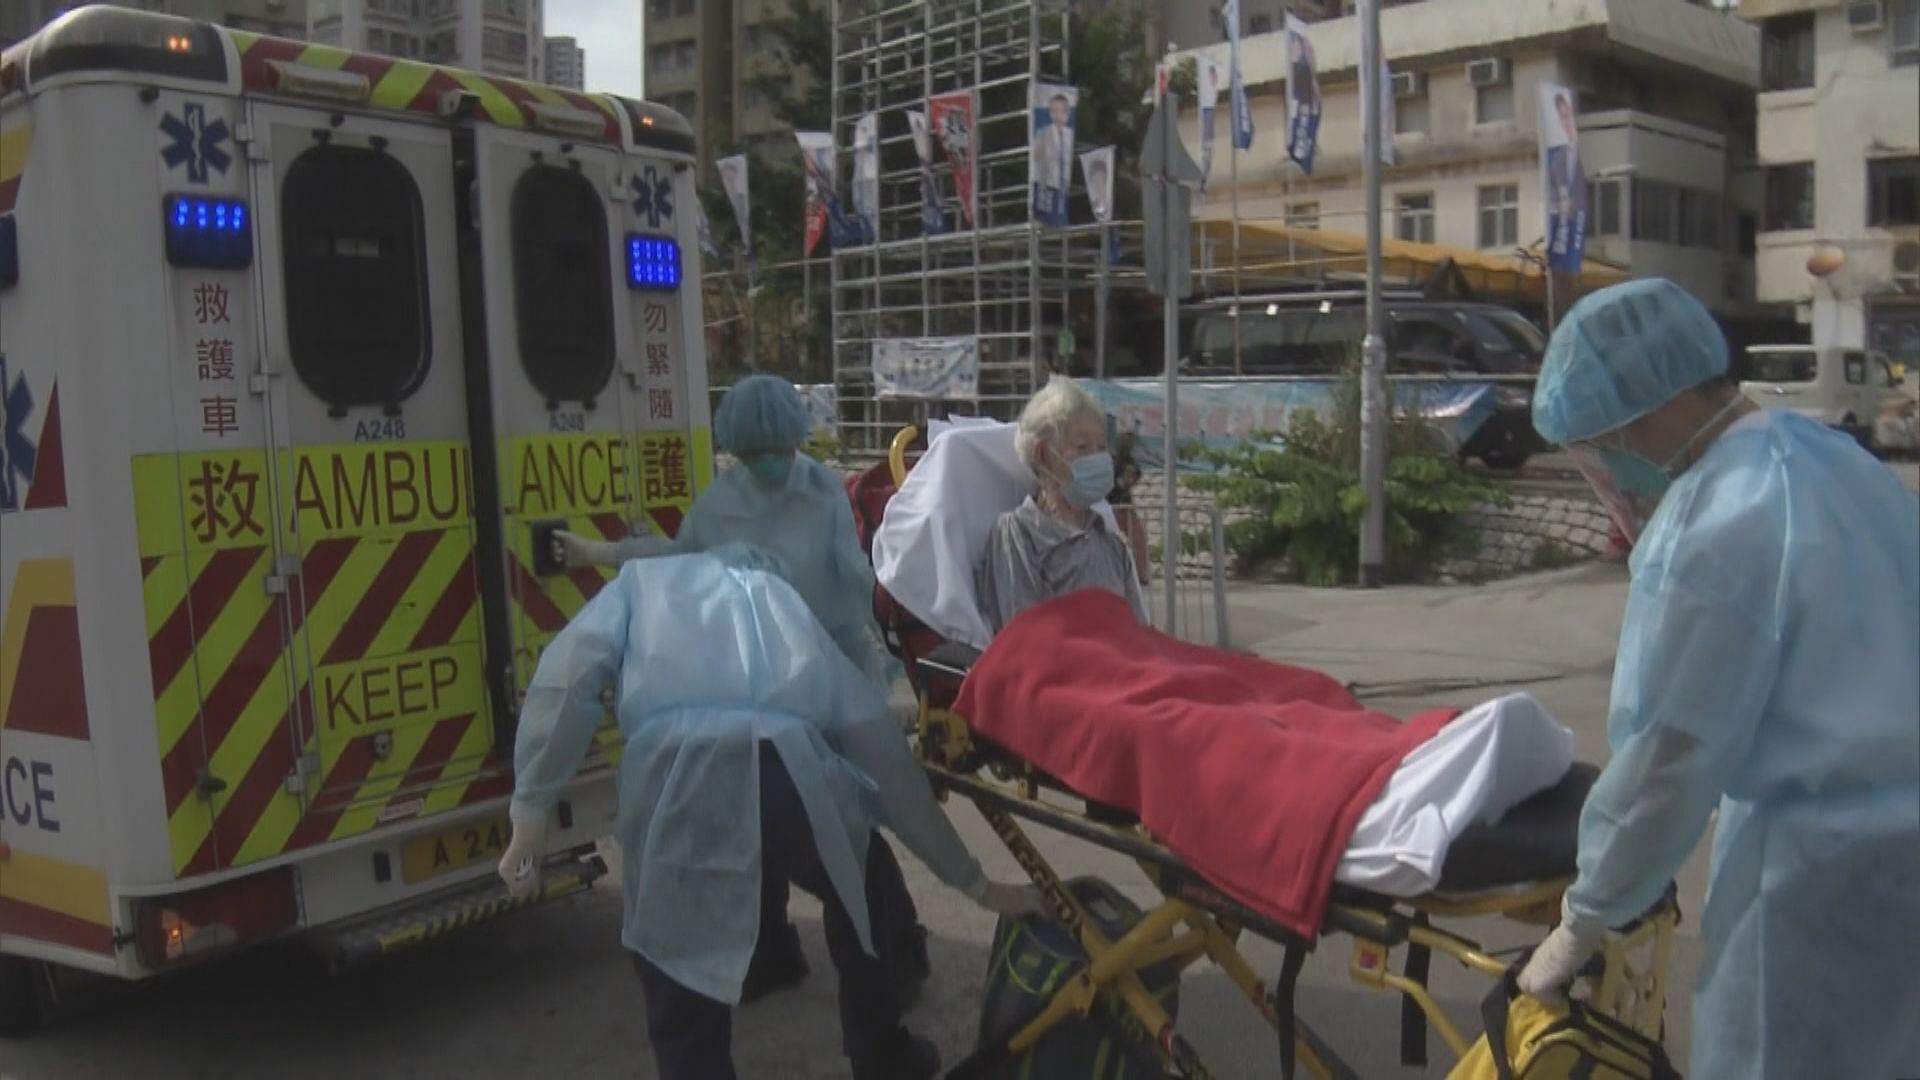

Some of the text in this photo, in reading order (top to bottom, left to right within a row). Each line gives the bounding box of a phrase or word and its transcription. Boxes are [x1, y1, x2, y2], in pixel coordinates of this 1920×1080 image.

[193, 281, 239, 438] 救護車
[643, 301, 673, 420] 勿緊隨
[354, 420, 406, 442] A248
[550, 412, 586, 432] A248
[189, 460, 265, 543] 救
[642, 437, 689, 501] 護
[325, 656, 458, 730] KEEP
[0, 756, 60, 832] CE
[463, 822, 513, 860] 24
